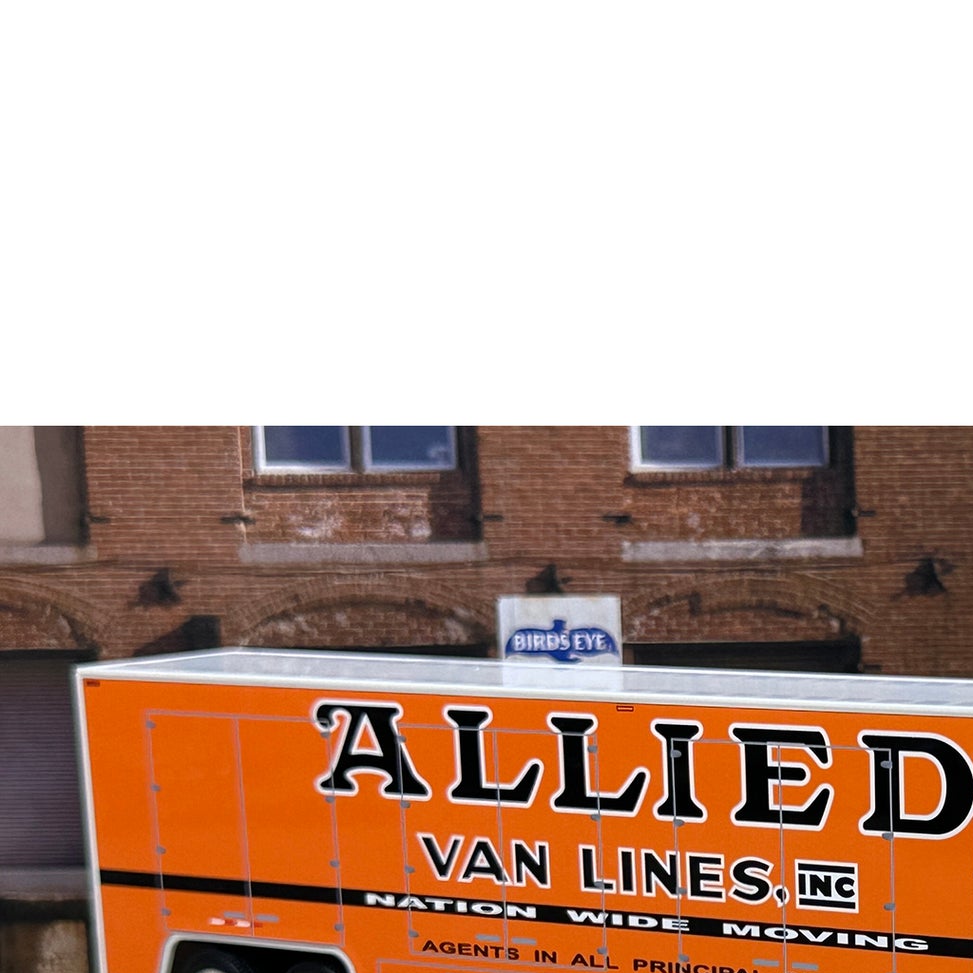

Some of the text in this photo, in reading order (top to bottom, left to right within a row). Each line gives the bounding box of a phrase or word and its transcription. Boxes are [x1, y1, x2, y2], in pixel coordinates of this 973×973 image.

[574, 634, 607, 650] EYE
[417, 833, 856, 907] VAN LINES, INC
[364, 893, 929, 951] NATION WIDE MOVING
[422, 940, 520, 961] AGENTS
[534, 950, 558, 964] IN
[570, 954, 619, 970] ALL
